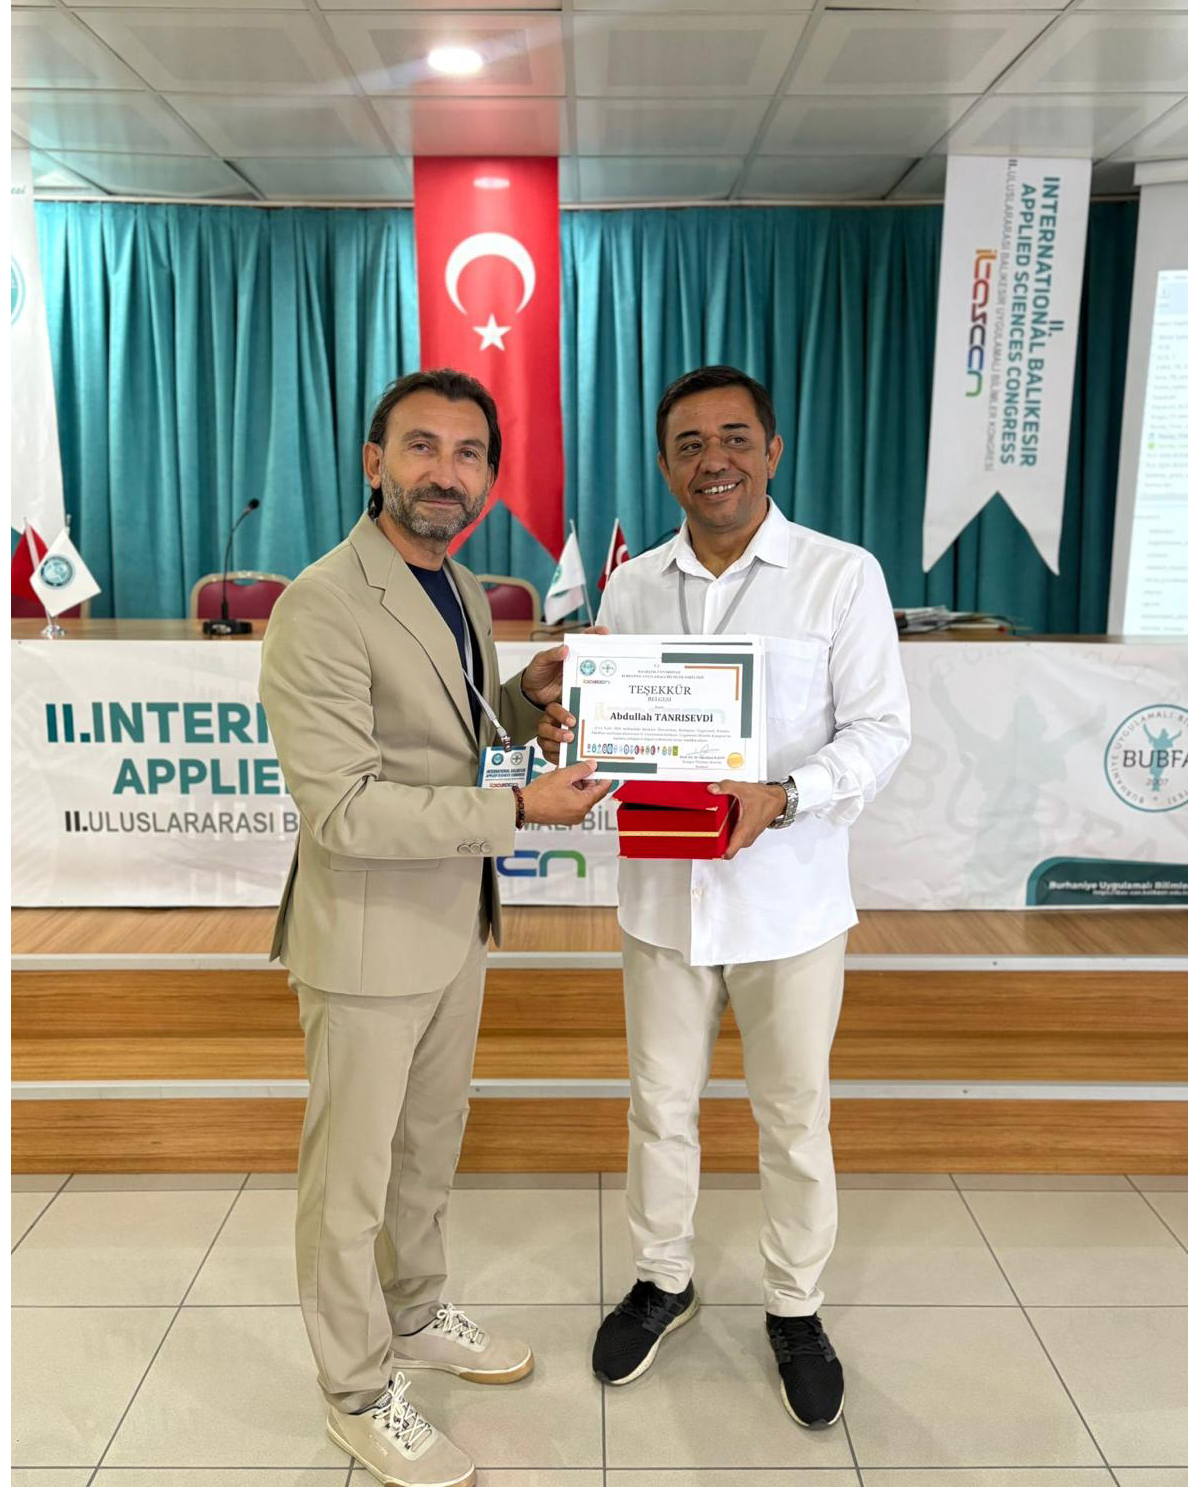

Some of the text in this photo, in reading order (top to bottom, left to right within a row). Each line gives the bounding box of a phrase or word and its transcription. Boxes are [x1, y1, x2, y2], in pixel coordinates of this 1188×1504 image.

[1000, 184, 1036, 465] APPLIED SCIENCES CONGRESS
[1020, 177, 1060, 467] INTERNATIONAL BALIKESIR
[1048, 320, 1064, 336] II.
[629, 684, 691, 696] TEŞEKKÜR
[610, 711, 713, 722] Abdullah TANRISEVDİ
[113, 758, 291, 794] APPLIE
